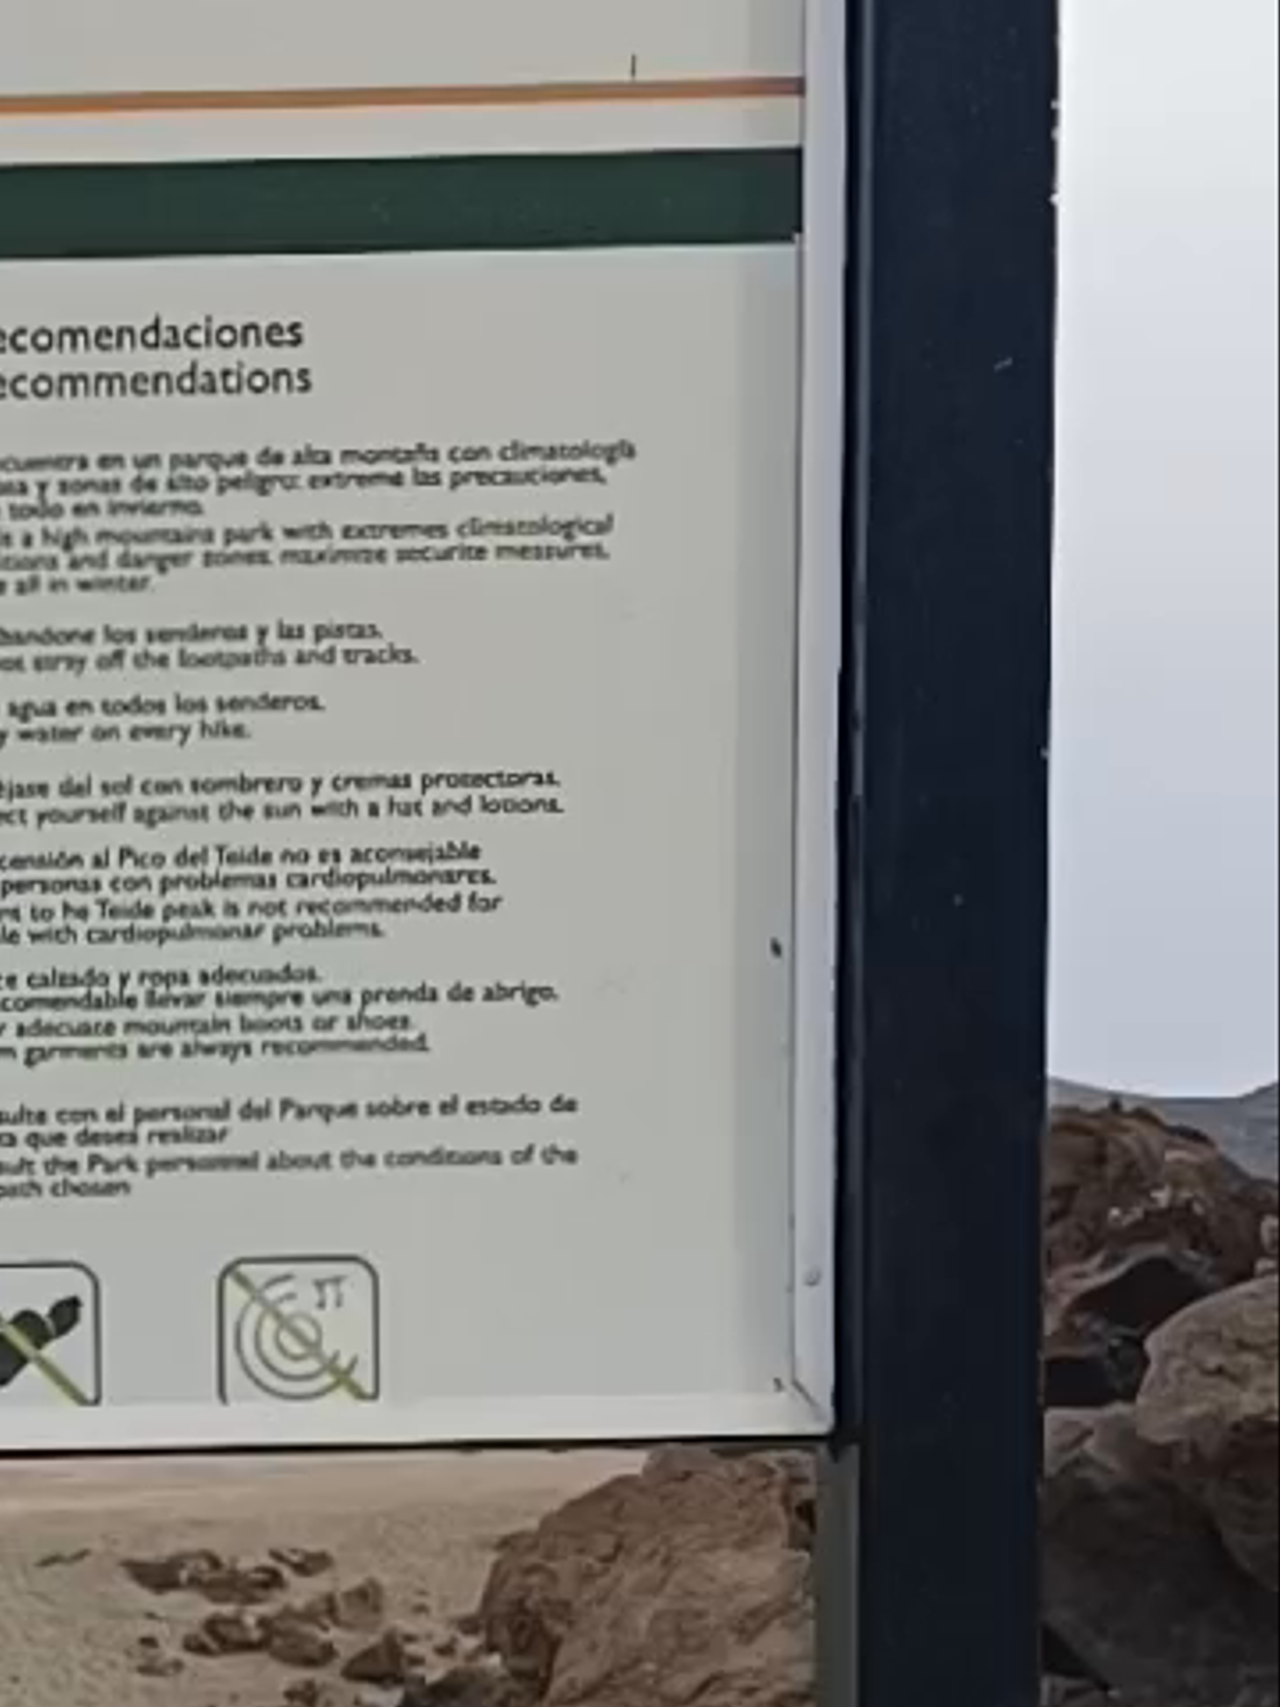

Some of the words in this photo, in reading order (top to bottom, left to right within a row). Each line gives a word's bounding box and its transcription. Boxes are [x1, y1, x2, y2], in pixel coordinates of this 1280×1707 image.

[103, 623, 137, 644] los
[257, 625, 268, 646] y
[277, 620, 305, 641] las
[96, 649, 124, 670] off
[133, 648, 169, 669] the
[295, 645, 336, 666] and
[8, 699, 57, 720] agua
[66, 699, 93, 715] en
[101, 692, 166, 714] todos
[175, 691, 208, 712] los
[17, 723, 81, 743] water
[91, 726, 120, 742] on
[129, 725, 190, 746] every
[59, 774, 92, 796] del
[101, 774, 133, 795] sol
[140, 778, 183, 794] con
[190, 771, 302, 793] sombrero
[311, 775, 322, 795] y
[37, 801, 125, 827] yourself
[133, 801, 209, 826] against
[218, 799, 254, 820] the
[263, 803, 301, 819] sun
[311, 797, 359, 818] with
[368, 801, 380, 817] a
[432, 795, 472, 816] and
[92, 848, 109, 869] al
[118, 847, 166, 868] Pico
[174, 846, 208, 867] del
[215, 845, 272, 866] Teide
[280, 849, 309, 865] no
[318, 849, 341, 865] es
[0, 876, 101, 898] personas
[110, 875, 152, 892] con
[159, 868, 277, 895] problemas
[30, 902, 54, 921] to
[97, 898, 154, 920] Teide
[162, 897, 214, 923] peak
[223, 898, 239, 917] is
[248, 897, 286, 917] not
[296, 893, 461, 916] recommended
[468, 892, 502, 913] for
[28, 922, 77, 943] with
[119, 971, 130, 991] y
[138, 969, 190, 990] ropa
[215, 987, 304, 1012] siempre
[312, 989, 352, 1006] una
[447, 982, 474, 1003] de
[123, 1014, 231, 1035] mountain
[312, 1016, 336, 1032] or
[137, 1043, 173, 1059] are
[181, 1036, 252, 1062] always
[56, 1107, 98, 1123] con
[106, 1102, 125, 1122] el
[133, 1100, 231, 1126] personal
[239, 1099, 271, 1120] del
[280, 1097, 358, 1124] Parque
[366, 1096, 430, 1117] sobre
[439, 1095, 458, 1116] el
[466, 1094, 541, 1116] estado
[550, 1093, 578, 1114] de
[25, 1130, 67, 1151] que
[44, 1153, 79, 1174] the
[87, 1152, 138, 1173] Park
[267, 1148, 331, 1170] about
[340, 1148, 376, 1169] the
[511, 1145, 533, 1166] of
[541, 1144, 578, 1165] the
